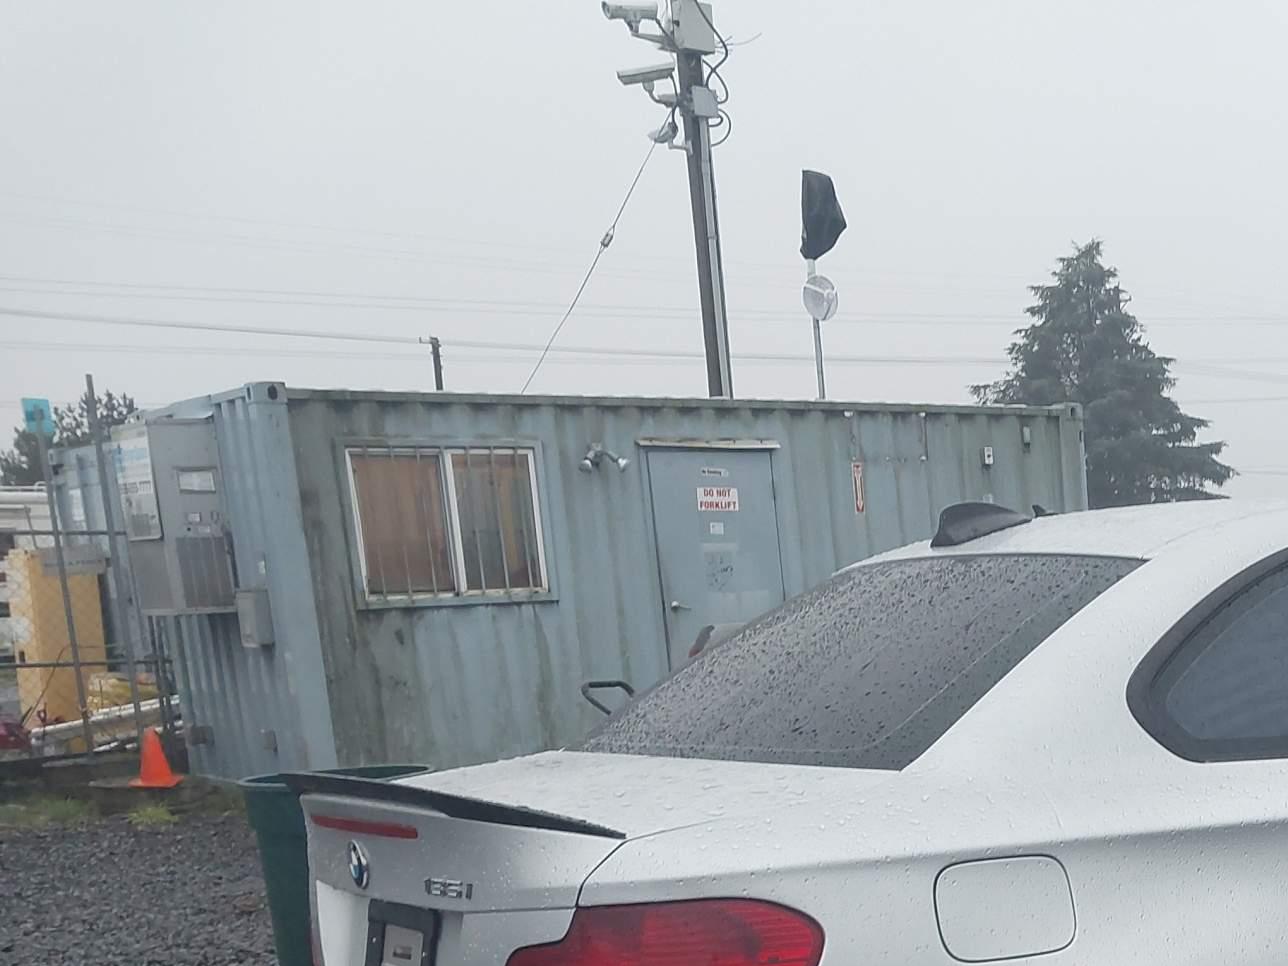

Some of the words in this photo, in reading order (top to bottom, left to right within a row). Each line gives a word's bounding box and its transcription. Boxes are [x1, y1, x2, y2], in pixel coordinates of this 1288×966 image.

[703, 488, 714, 497] DO
[716, 488, 731, 497] NOT
[699, 500, 737, 510] FORKLIFT
